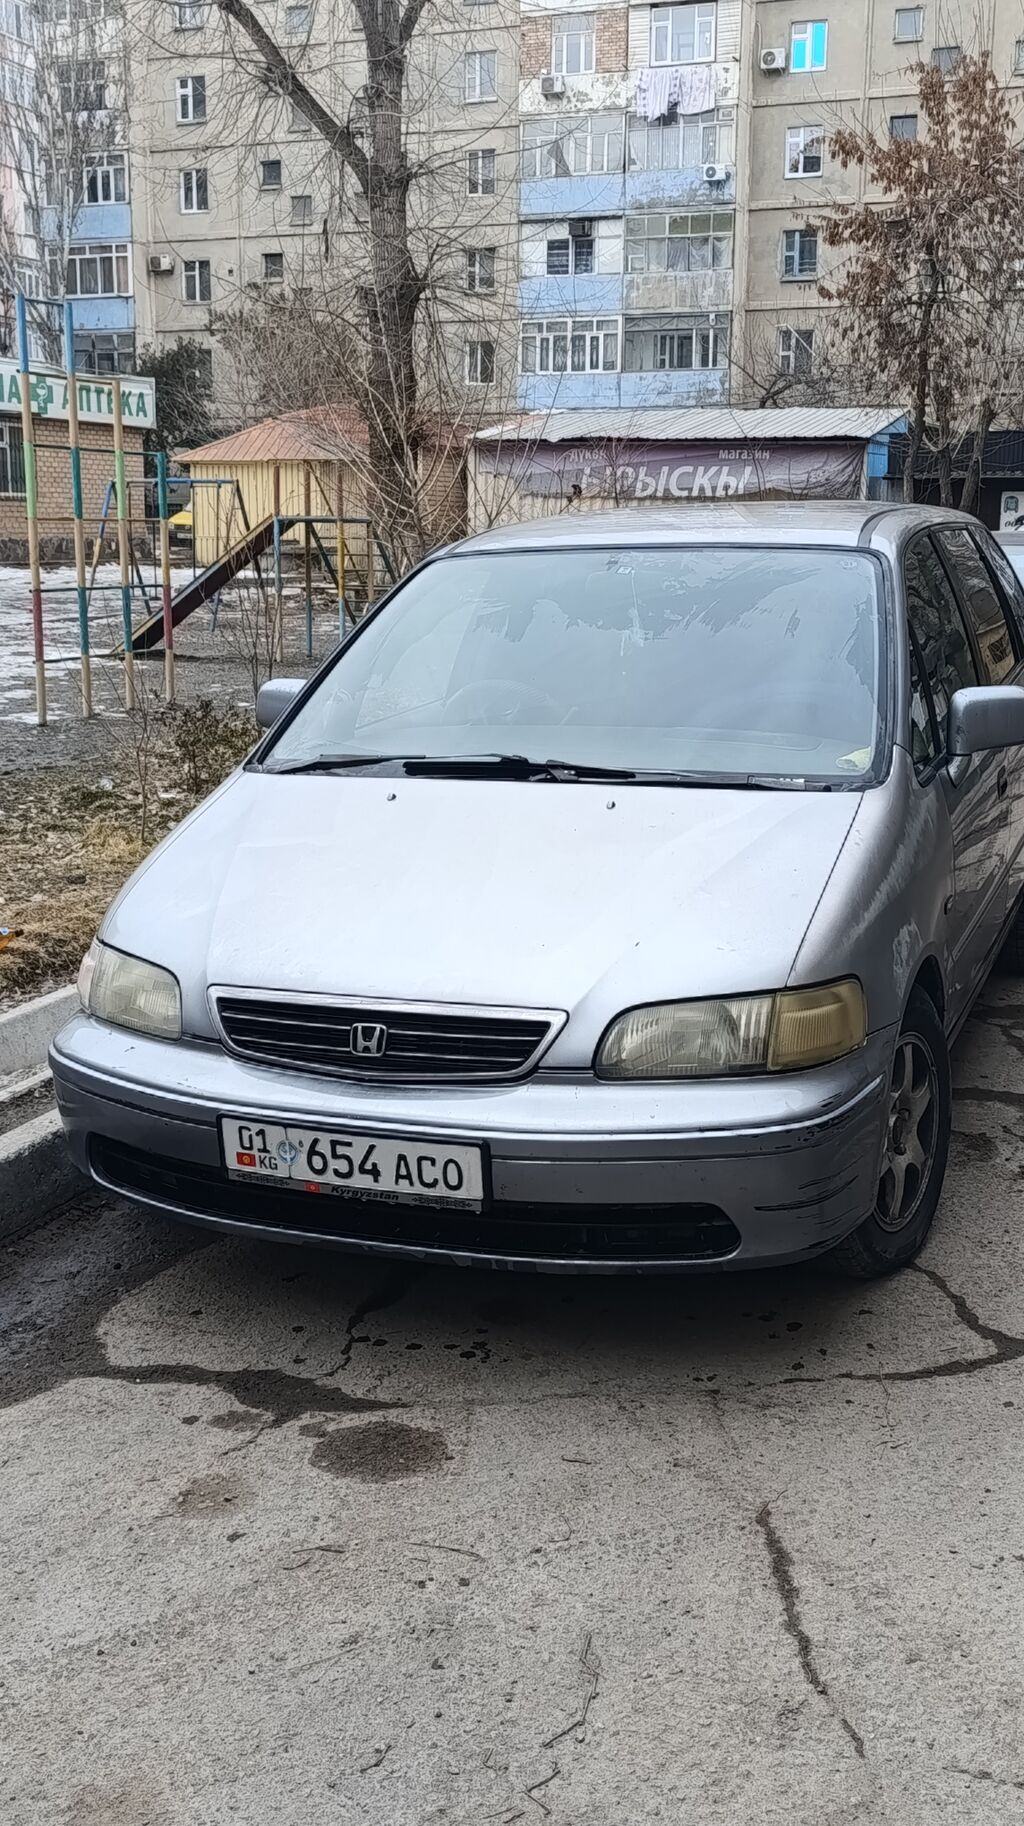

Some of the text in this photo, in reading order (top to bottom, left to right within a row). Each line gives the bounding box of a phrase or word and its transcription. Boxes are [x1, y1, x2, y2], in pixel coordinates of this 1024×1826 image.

[719, 449, 770, 460] магазин
[238, 1125, 271, 1154] 01
[306, 1137, 382, 1184] 654
[395, 1153, 464, 1191] ACO
[258, 1155, 279, 1171] KG
[331, 1186, 399, 1201] Kyrgyzstan
